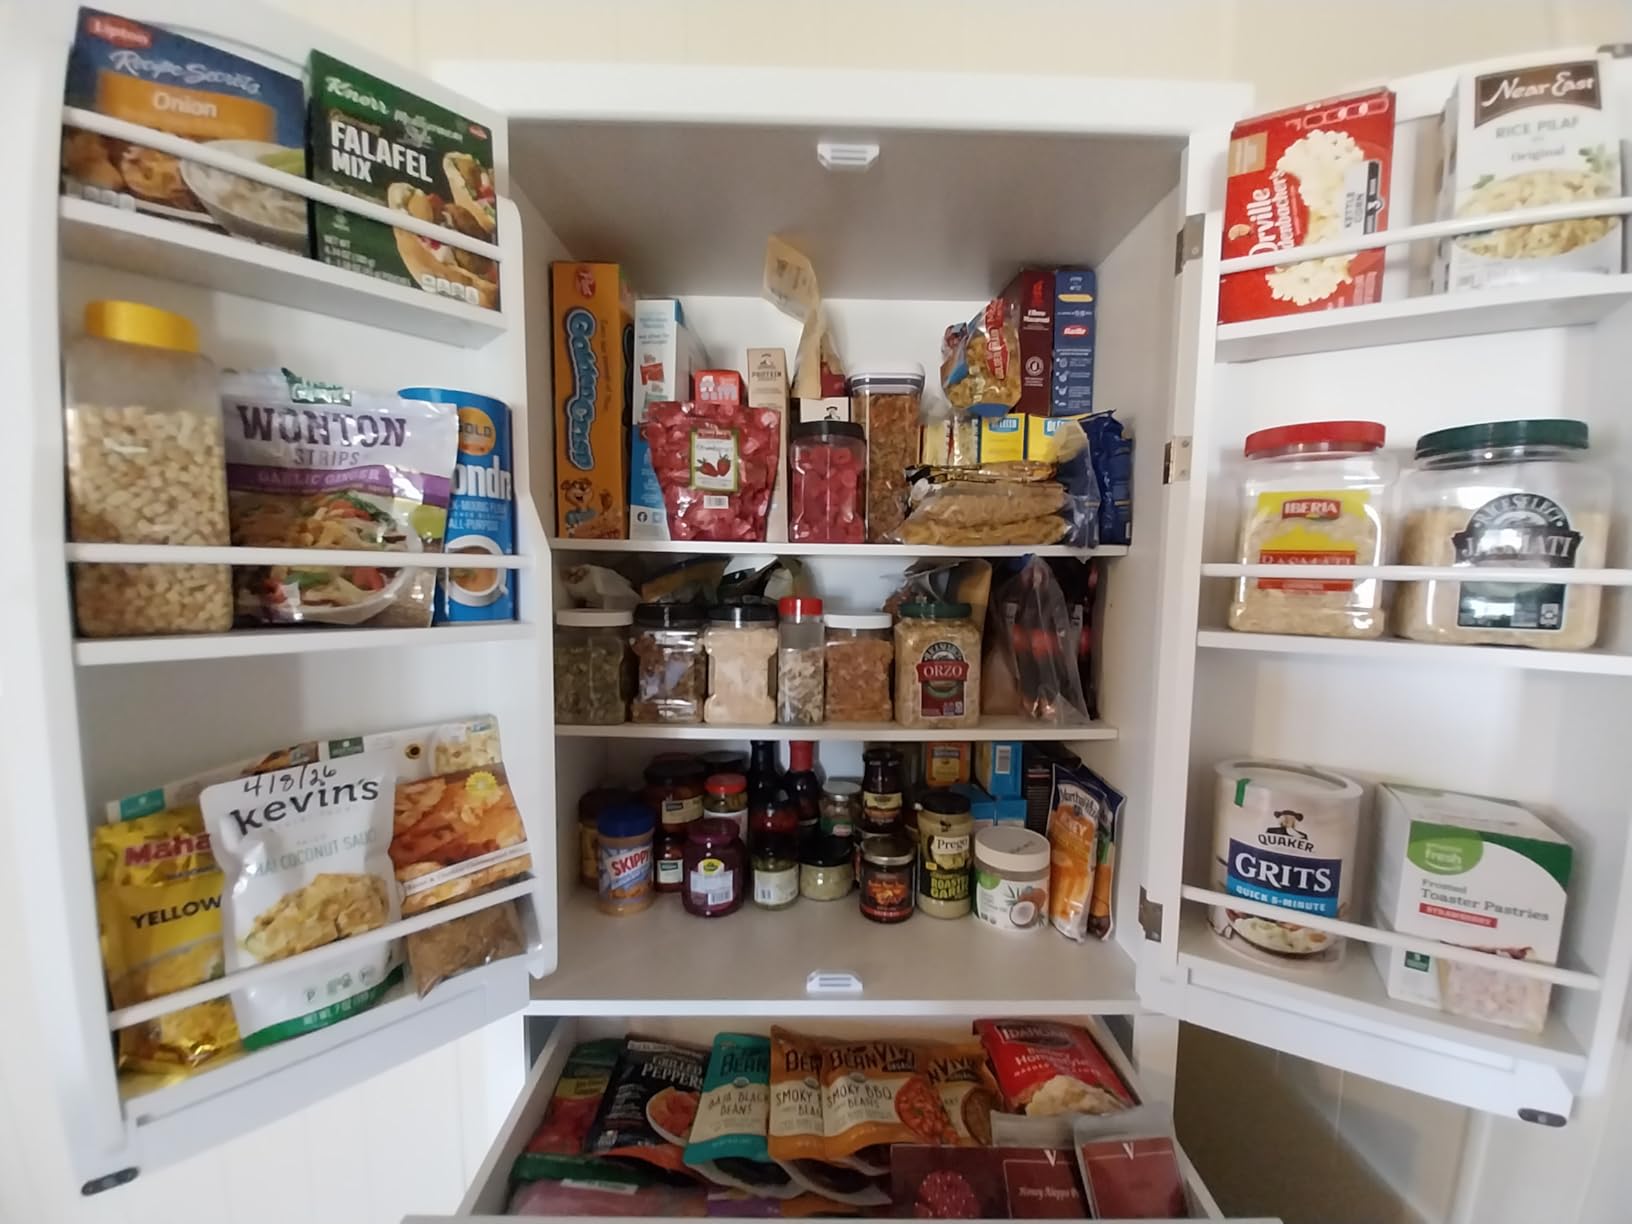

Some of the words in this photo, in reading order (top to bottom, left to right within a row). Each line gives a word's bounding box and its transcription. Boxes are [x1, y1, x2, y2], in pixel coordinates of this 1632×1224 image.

[325, 75, 390, 115] Knorr
[1481, 77, 1551, 107] Near
[1551, 71, 1595, 97] East
[152, 90, 218, 118] Onion
[1496, 120, 1531, 139] RICE
[1537, 115, 1580, 132] PILAF
[331, 119, 434, 183] FALAFEL
[331, 149, 373, 184] MIX
[237, 405, 407, 448] WONTON
[294, 447, 360, 467] STRIPS
[1284, 501, 1338, 514] IBERIA
[923, 664, 963, 678] ORZO
[230, 778, 379, 836] kevin's
[280, 839, 339, 870] COCONUT
[1258, 833, 1315, 853] QUAKER
[1425, 847, 1463, 864] fresh
[1235, 852, 1332, 893] GRITS
[131, 895, 222, 929] YELLOW
[1236, 884, 1269, 903] QUICK
[1271, 896, 1327, 912] 5-MINUTE
[1421, 887, 1481, 909] Toaster
[1484, 900, 1550, 921] Pastries
[775, 1089, 813, 1106] SMOKY
[865, 1083, 893, 1100] BBQ
[721, 1103, 752, 1116] BEANS
